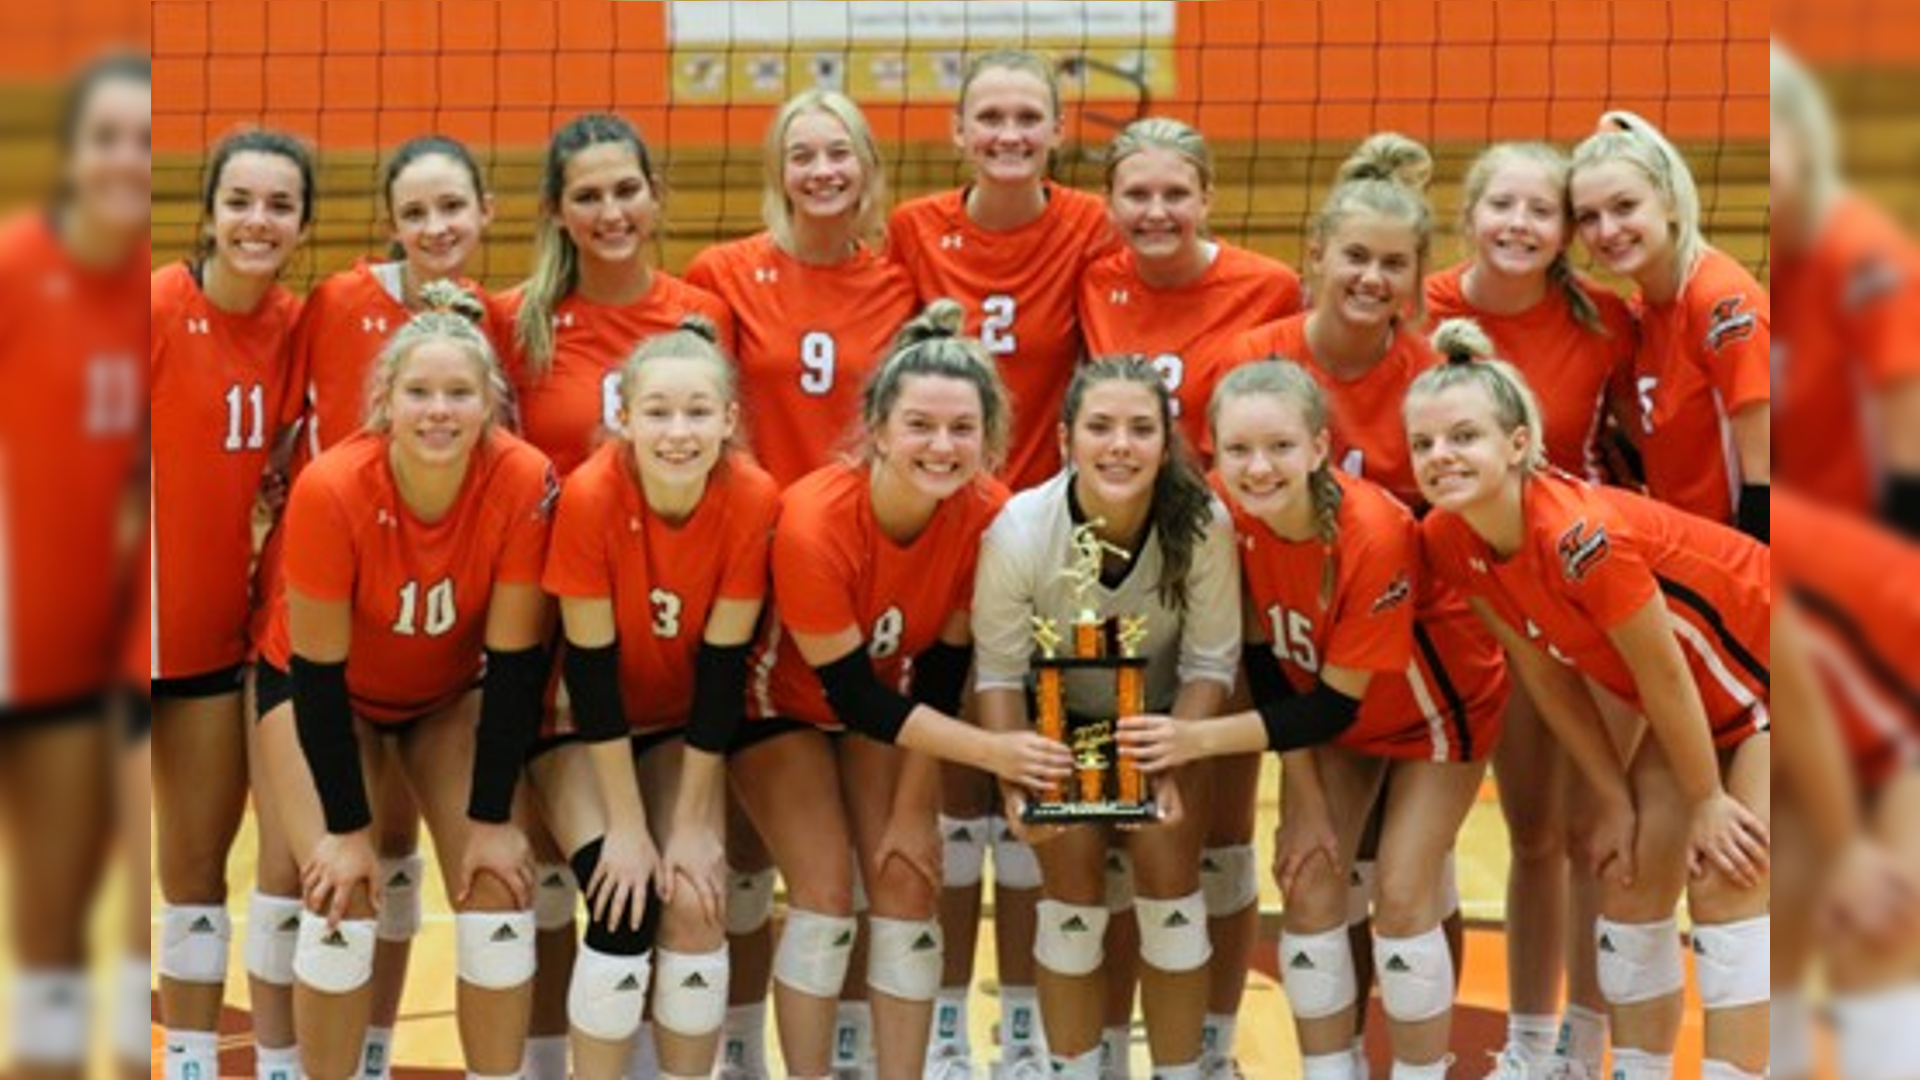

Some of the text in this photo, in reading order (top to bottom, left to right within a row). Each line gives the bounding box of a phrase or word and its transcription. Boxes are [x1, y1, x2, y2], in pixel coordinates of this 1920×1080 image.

[981, 295, 1016, 353] 2
[800, 331, 835, 393] 9
[226, 384, 263, 451] 11
[392, 577, 456, 636] 10
[649, 588, 681, 637] 3
[868, 606, 903, 658] 8
[1267, 603, 1318, 673] 15
